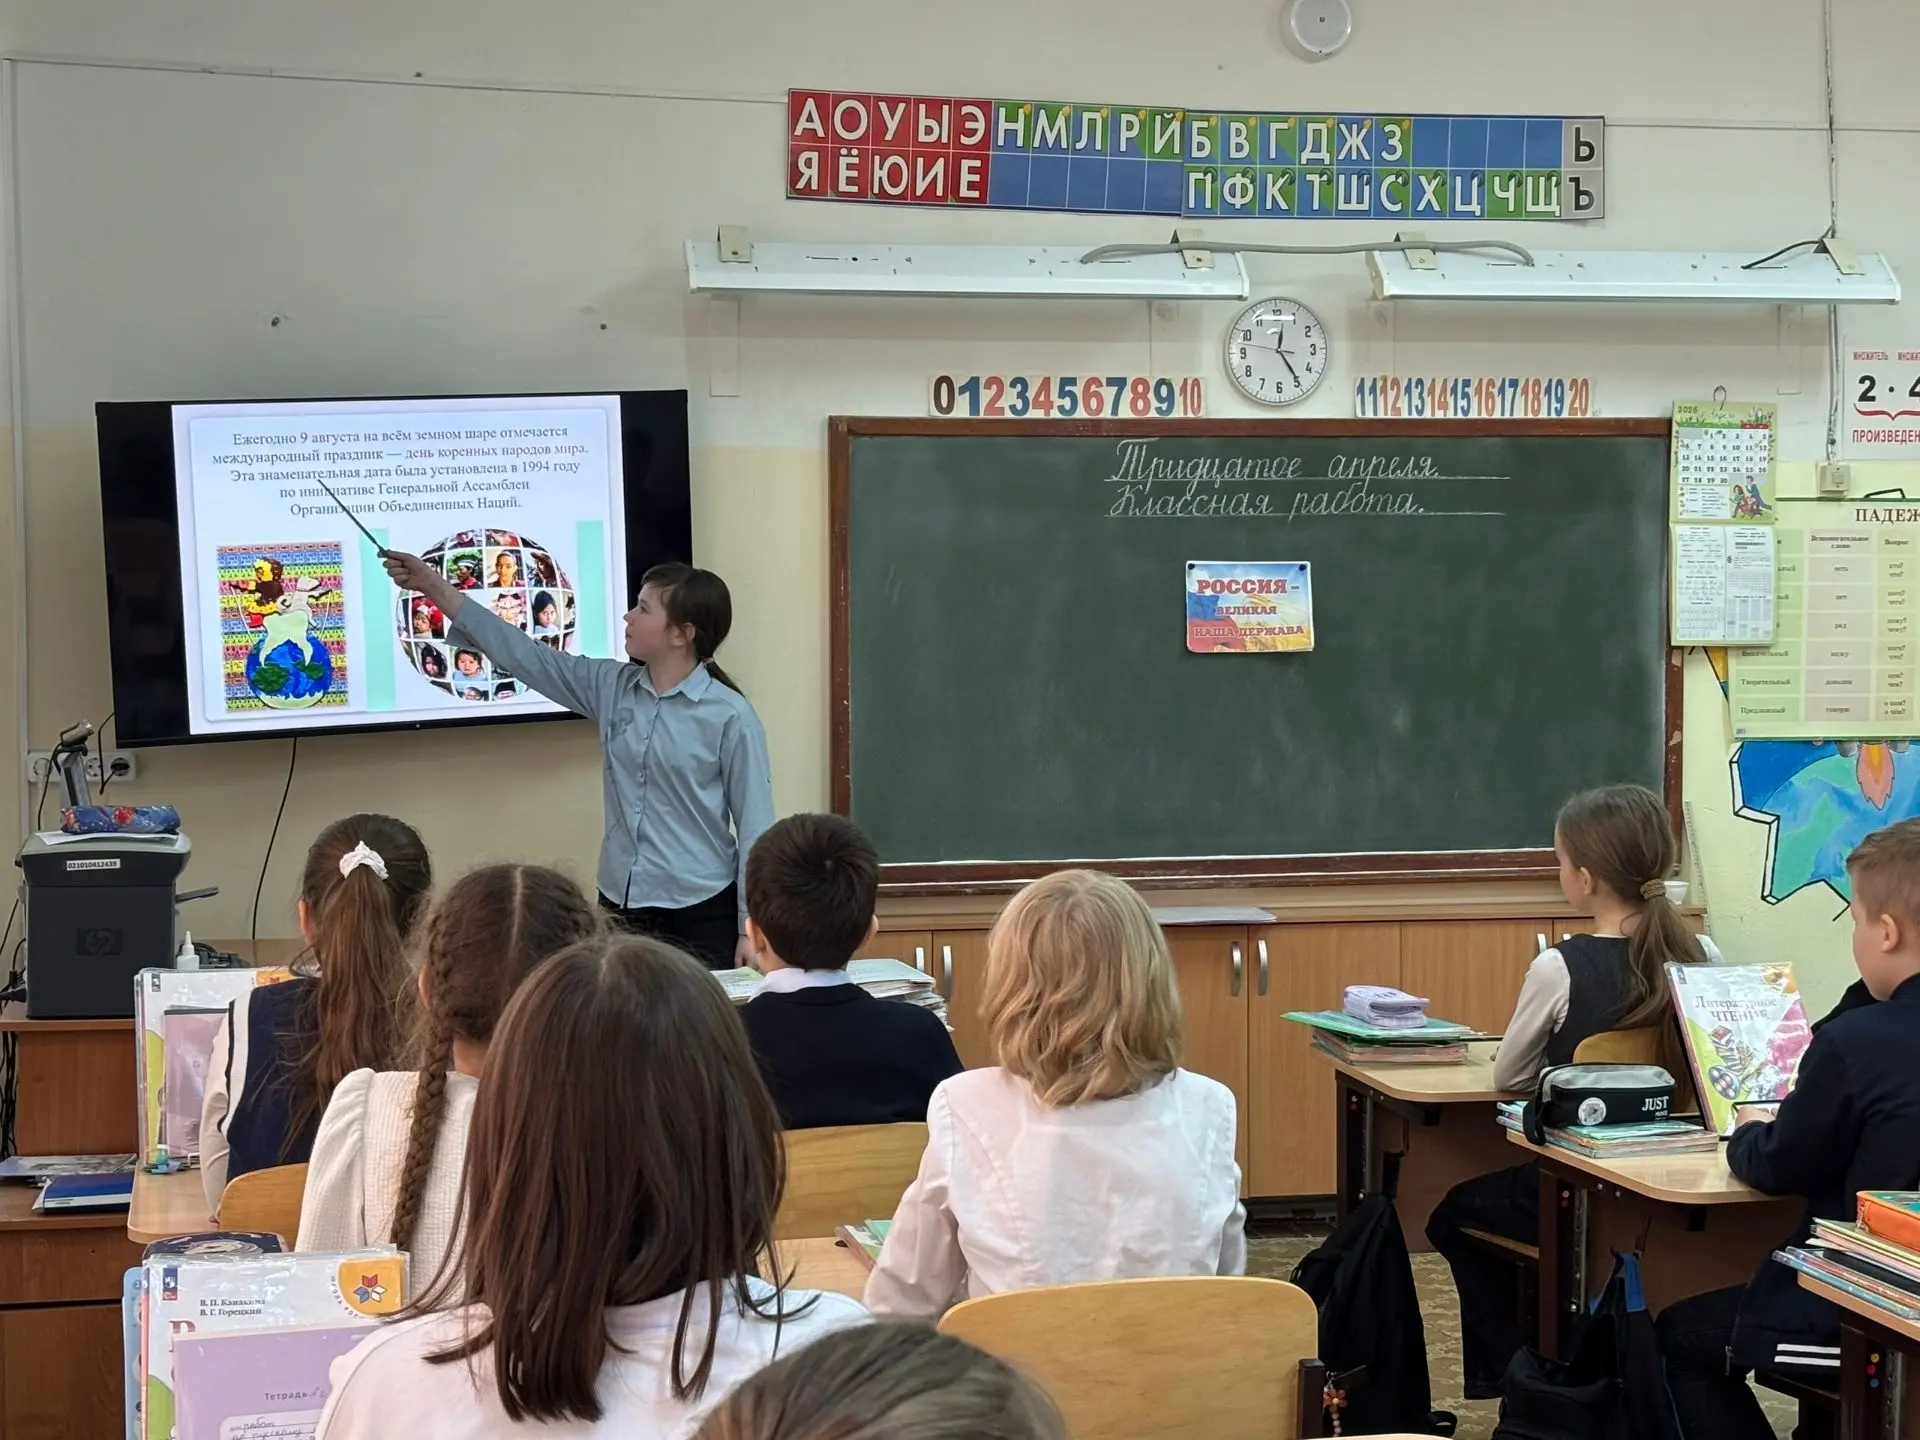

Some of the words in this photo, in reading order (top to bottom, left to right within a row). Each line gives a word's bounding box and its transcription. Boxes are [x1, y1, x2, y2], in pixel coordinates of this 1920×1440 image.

[1241, 329, 1252, 341] 10
[1305, 325, 1311, 338] 2
[1240, 347, 1246, 359] 9
[1310, 343, 1316, 356] 3
[1245, 365, 1252, 377] 8
[1306, 362, 1312, 373] 4
[1259, 378, 1265, 390] 7
[1276, 382, 1283, 393] 6
[1294, 376, 1300, 388] 5
[1858, 375, 1876, 402] 2
[1908, 376, 1920, 402] 4
[233, 433, 297, 446] Ежегодно
[300, 432, 308, 443] 9
[312, 432, 360, 445] августа
[364, 432, 378, 442] на
[382, 430, 411, 442] всём
[415, 430, 461, 440] земном
[465, 430, 497, 441] шаре
[500, 427, 568, 438] отмечается
[212, 450, 320, 466] международный
[324, 450, 383, 463] праздник
[405, 449, 434, 460] день
[438, 446, 498, 460] коренных
[502, 446, 550, 458] народов
[554, 444, 588, 456] мира.
[230, 470, 255, 482] Эта
[259, 468, 360, 480] знаменательная
[364, 468, 391, 479] дата
[395, 465, 427, 477] была
[430, 464, 507, 478] установлена
[511, 464, 518, 473] в
[522, 460, 550, 472] 1994
[553, 462, 580, 474] году
[1111, 437, 1302, 497] Тридцатое
[279, 488, 296, 498] по
[378, 480, 458, 496] Генеральной
[462, 479, 529, 492] Ассамблеи
[477, 496, 521, 509] Наций.
[1109, 484, 1273, 516] Классная
[1289, 482, 1425, 524] работа.
[1855, 508, 1920, 524] ПАДЕЖ
[1196, 578, 1288, 594] РОССИЯ
[1216, 605, 1277, 616] ВЕЛИКАЯ
[1195, 627, 1234, 637] НАША
[1239, 625, 1304, 637] ДЕРЖАВА
[1641, 1095, 1669, 1111] JUST
[218, 1307, 262, 1317] Горецкий
[265, 1391, 307, 1401] Тетрадь
